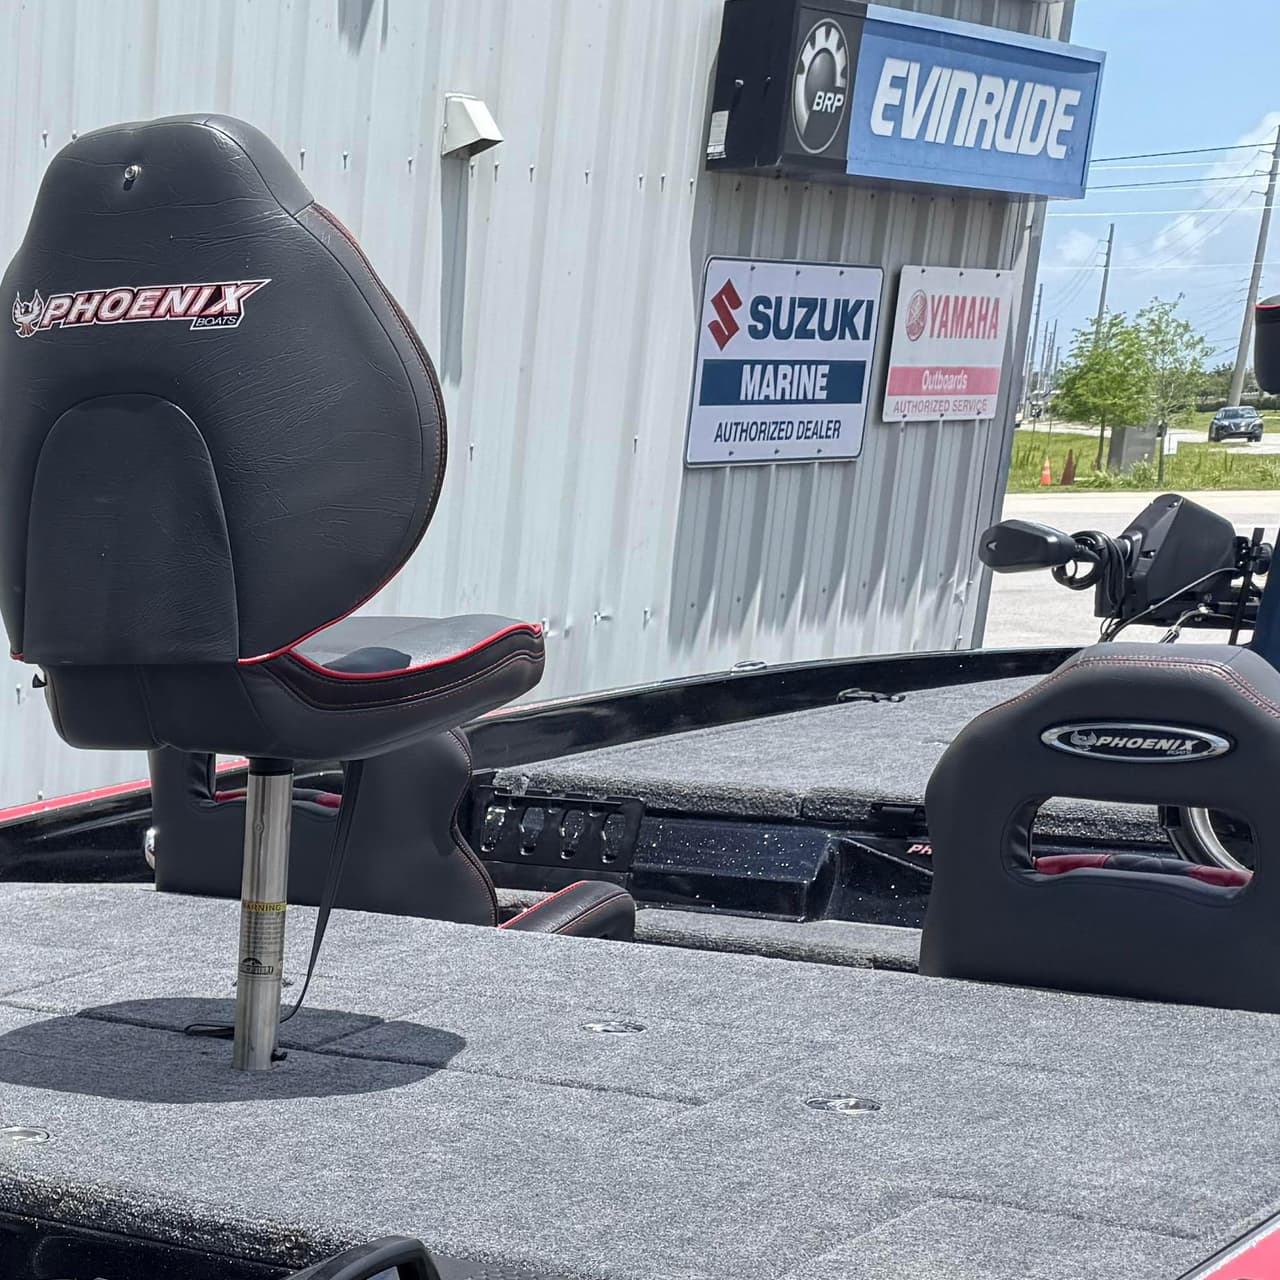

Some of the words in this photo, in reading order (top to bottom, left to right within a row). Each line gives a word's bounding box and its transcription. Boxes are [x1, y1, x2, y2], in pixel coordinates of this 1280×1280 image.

[812, 91, 844, 114] BRP
[871, 57, 1082, 160] EVINRUDE
[40, 282, 258, 329] PHOENIX
[929, 294, 1000, 340] YAMAHA
[195, 315, 238, 327] BOATS
[747, 295, 875, 342] SUZUKI
[740, 364, 830, 400] MARINE
[921, 368, 968, 390] Outboards
[893, 400, 951, 414] AUTHORIZED
[952, 398, 987, 413] SERVICE
[714, 421, 794, 443] AUTHORIZED
[796, 419, 841, 440] DEALER
[1095, 736, 1199, 752] PHOENIX
